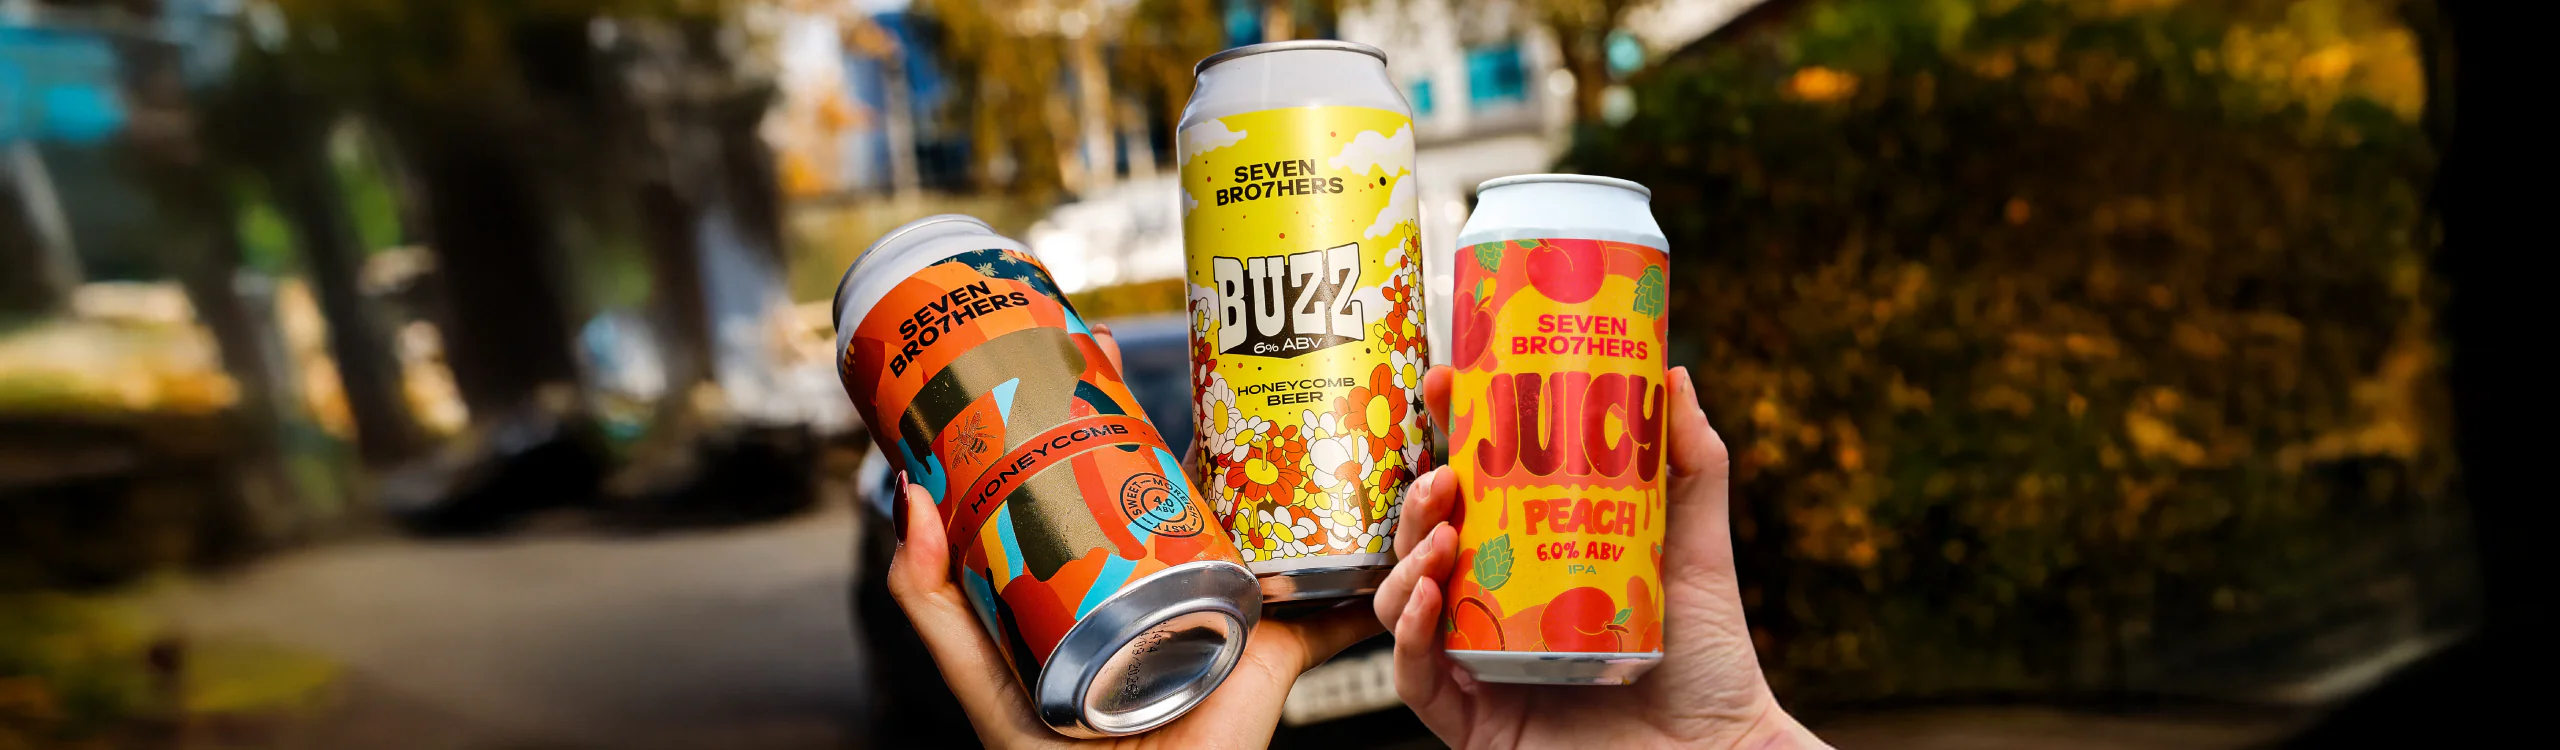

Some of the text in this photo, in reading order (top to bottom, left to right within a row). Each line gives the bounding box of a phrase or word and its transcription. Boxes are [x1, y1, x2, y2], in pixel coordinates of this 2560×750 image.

[1234, 159, 1316, 183] SEVEN
[1216, 177, 1344, 206] BRO7HERS
[899, 281, 991, 340] SEVEN
[1213, 242, 1365, 355] BUZZ
[889, 292, 1030, 379] BRO7HERS
[1537, 314, 1627, 336] SEVEN
[1254, 337, 1323, 354] 6% ABV
[1512, 335, 1648, 360] BRO7HERS
[1237, 377, 1356, 396] HONEYCOMB
[1267, 391, 1323, 406] BEER
[1477, 371, 1665, 482] JUICY
[970, 424, 1129, 514] HONEYCOMB
[1127, 478, 1198, 533] SWEET MOREISH TASTY
[1153, 496, 1174, 508] 4.0
[1155, 506, 1175, 514] ABV
[1523, 498, 1637, 537] PEACH
[1537, 541, 1625, 562] 6.0% ABV
[1568, 564, 1597, 575] IPA
